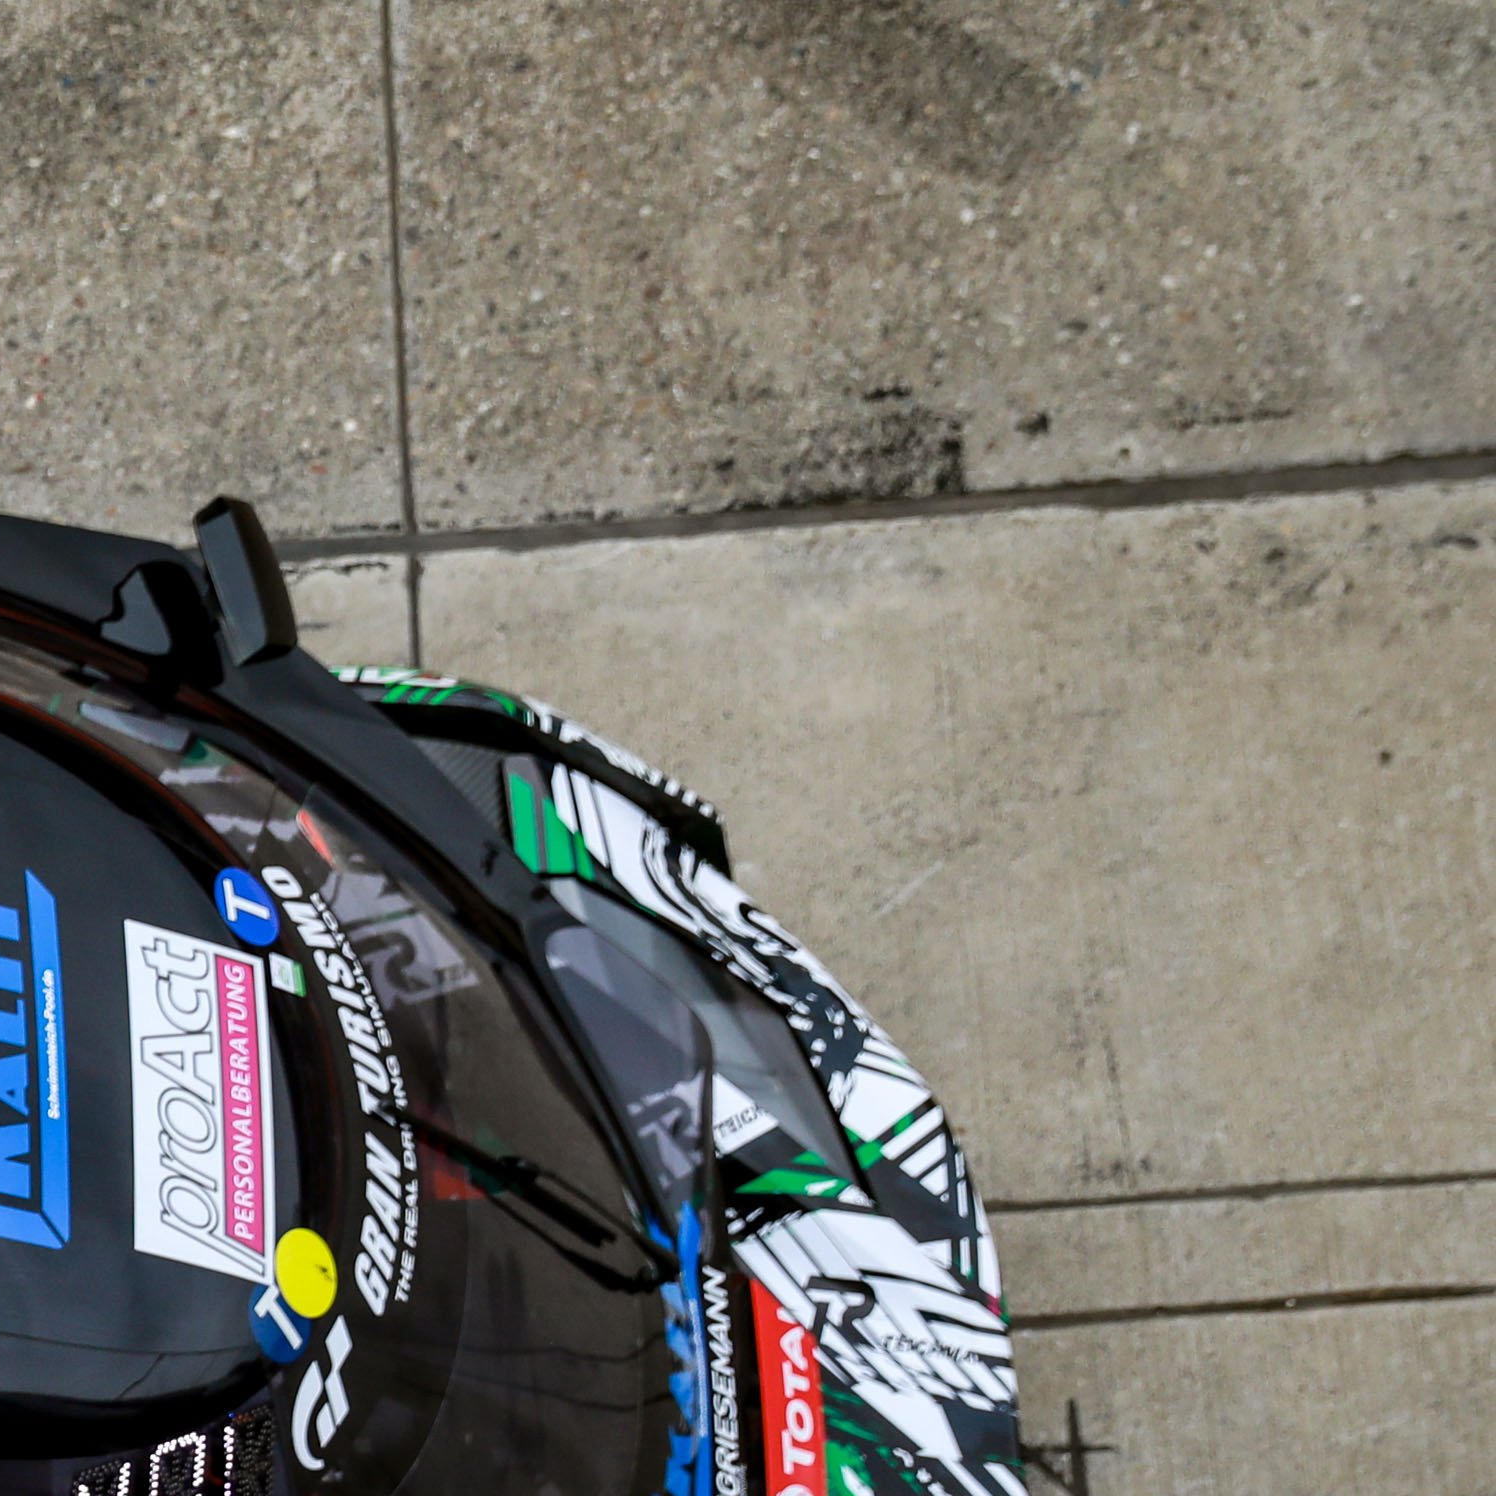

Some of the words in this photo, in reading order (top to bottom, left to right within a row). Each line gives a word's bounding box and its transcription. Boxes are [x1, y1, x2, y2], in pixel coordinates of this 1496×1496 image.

[140, 937, 266, 1277] proAct
[223, 963, 256, 1241] PERSONALBERATUNG
[260, 865, 398, 1127] TURISMO
[354, 1130, 402, 1317] GRAN
[394, 1249, 416, 1303] THE
[403, 1178, 419, 1248] REAL
[702, 1264, 740, 1496] GRIESEMANN
